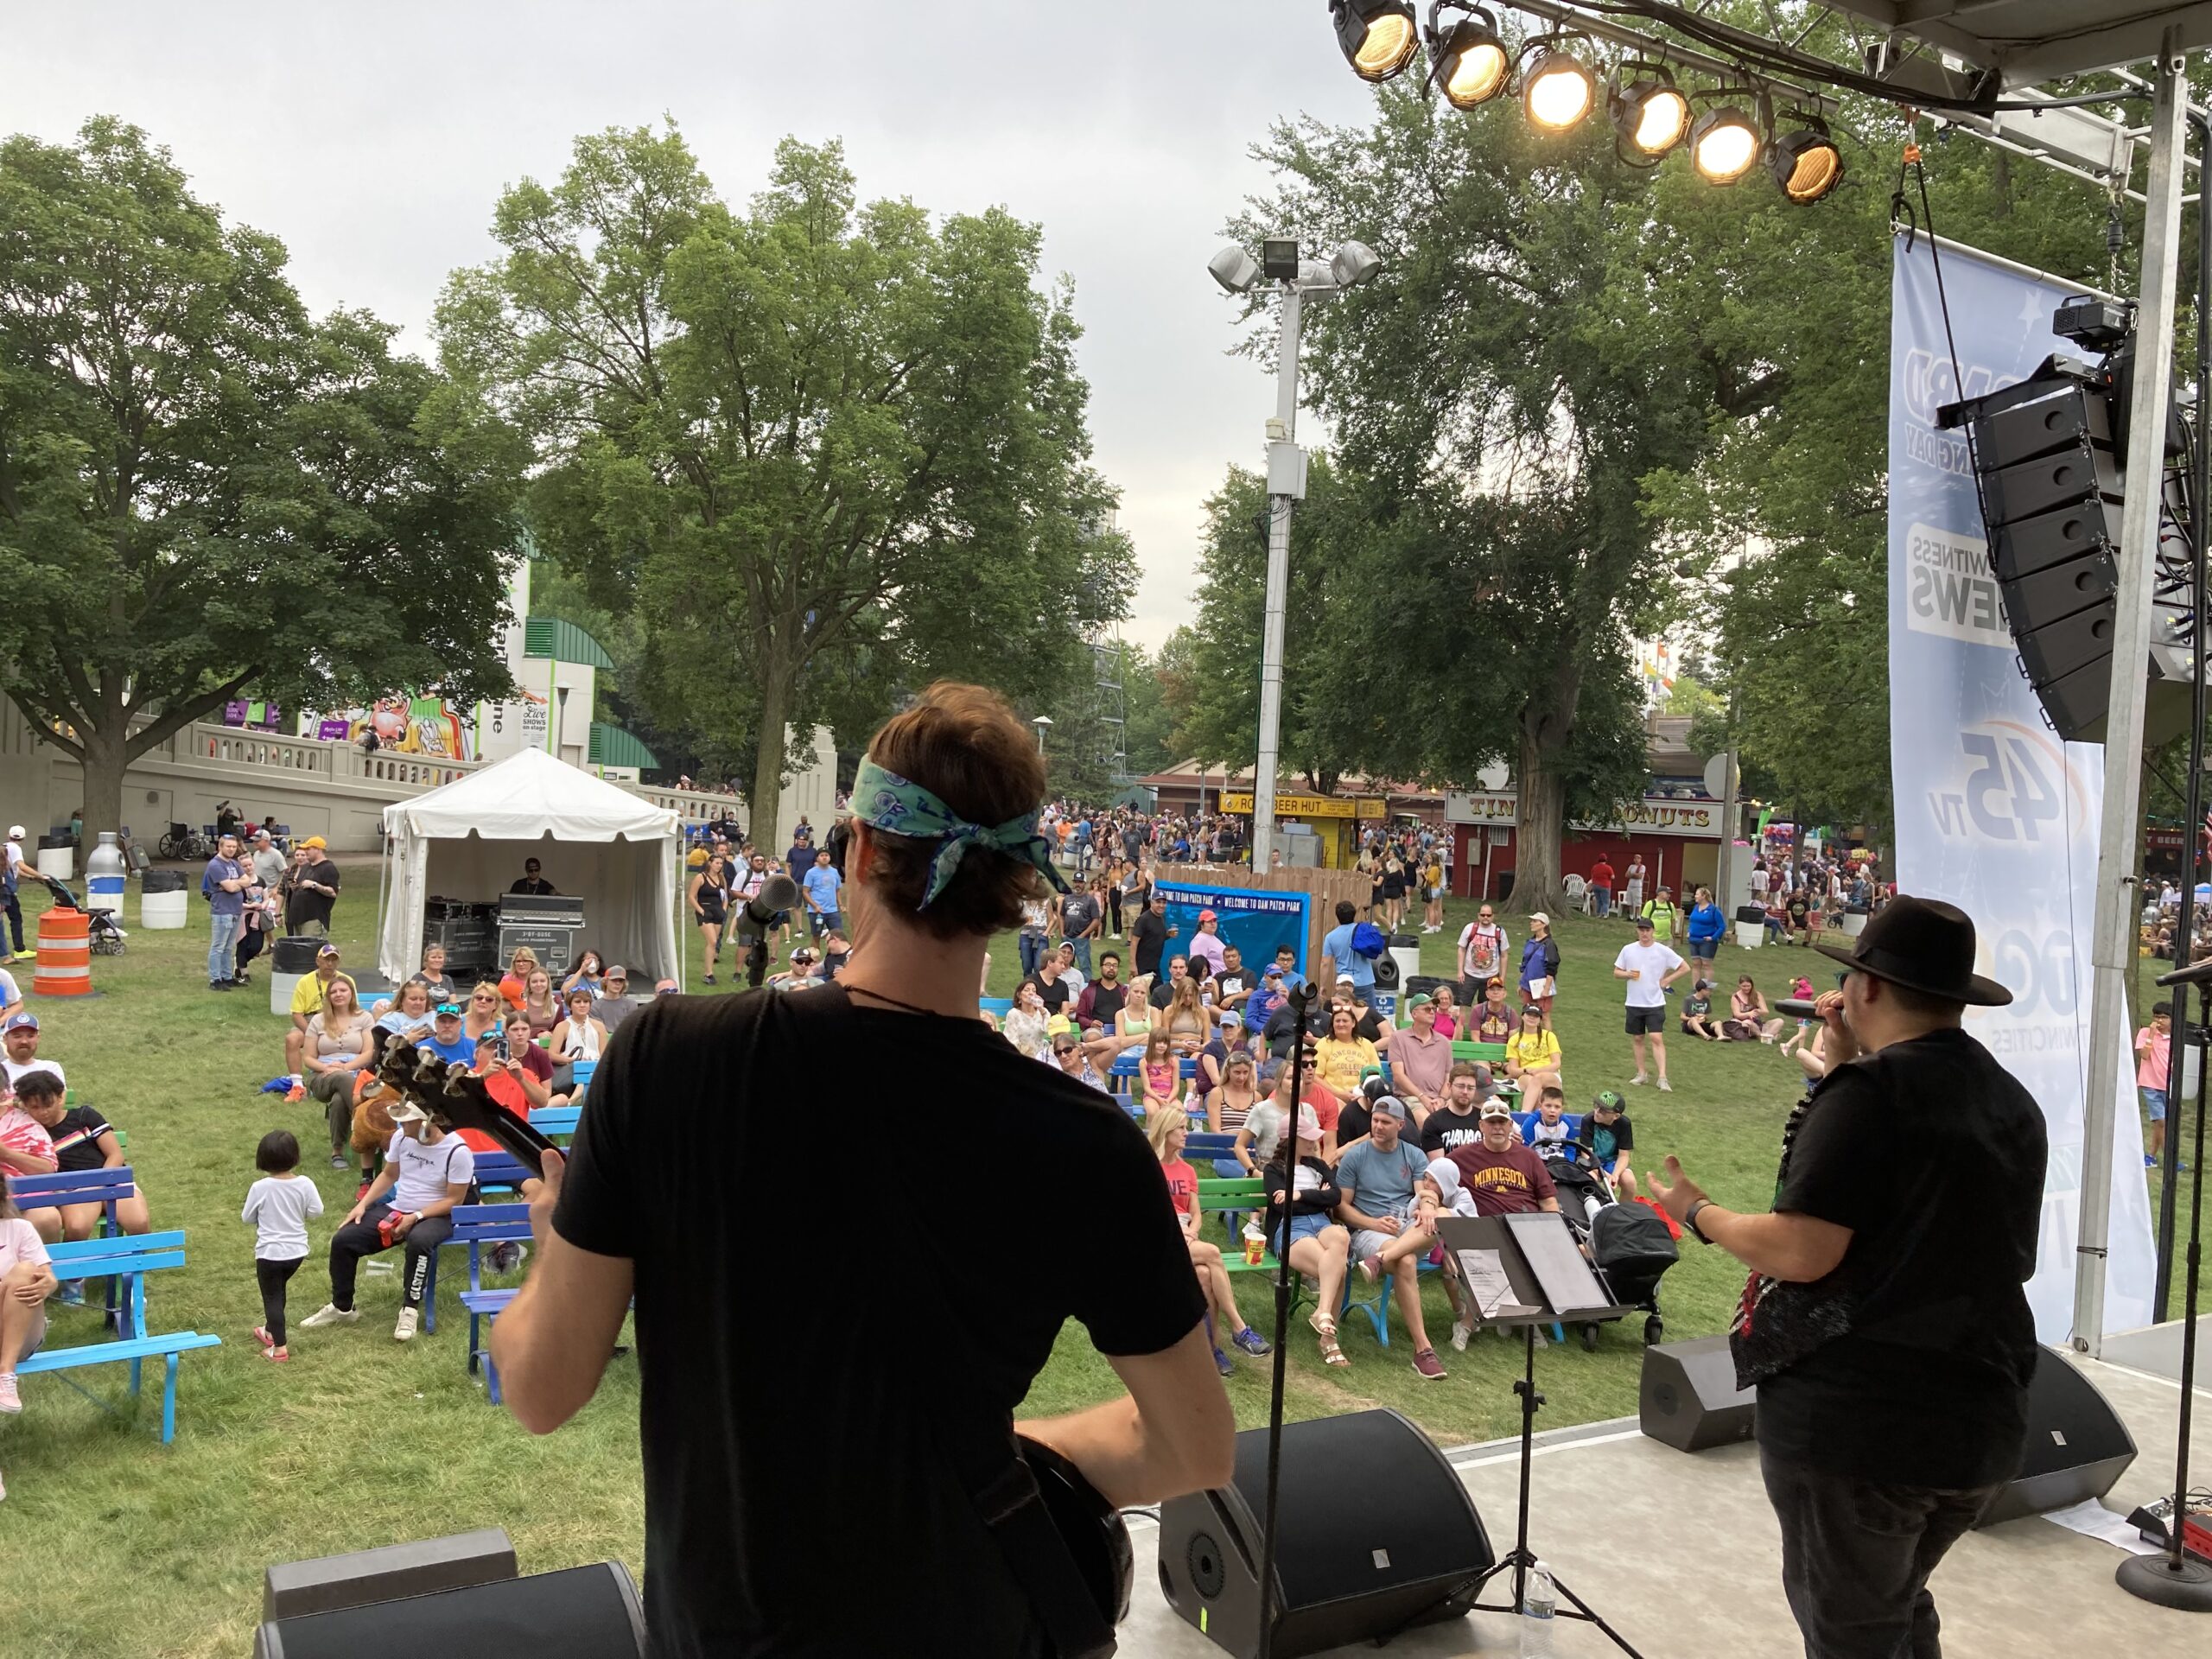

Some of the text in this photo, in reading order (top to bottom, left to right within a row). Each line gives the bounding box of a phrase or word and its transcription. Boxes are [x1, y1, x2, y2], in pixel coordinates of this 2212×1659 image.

[524, 706, 546, 718] Live
[1241, 798, 1321, 813] RO BEER HUT
[1470, 798, 1516, 817] TIN
[1190, 893, 1202, 904] PATCH
[1203, 895, 1213, 906] PARK
[1224, 897, 1300, 912] WELCOME TO DAN PATCH PARK
[1475, 1166, 1527, 1189] MINNESOTA
